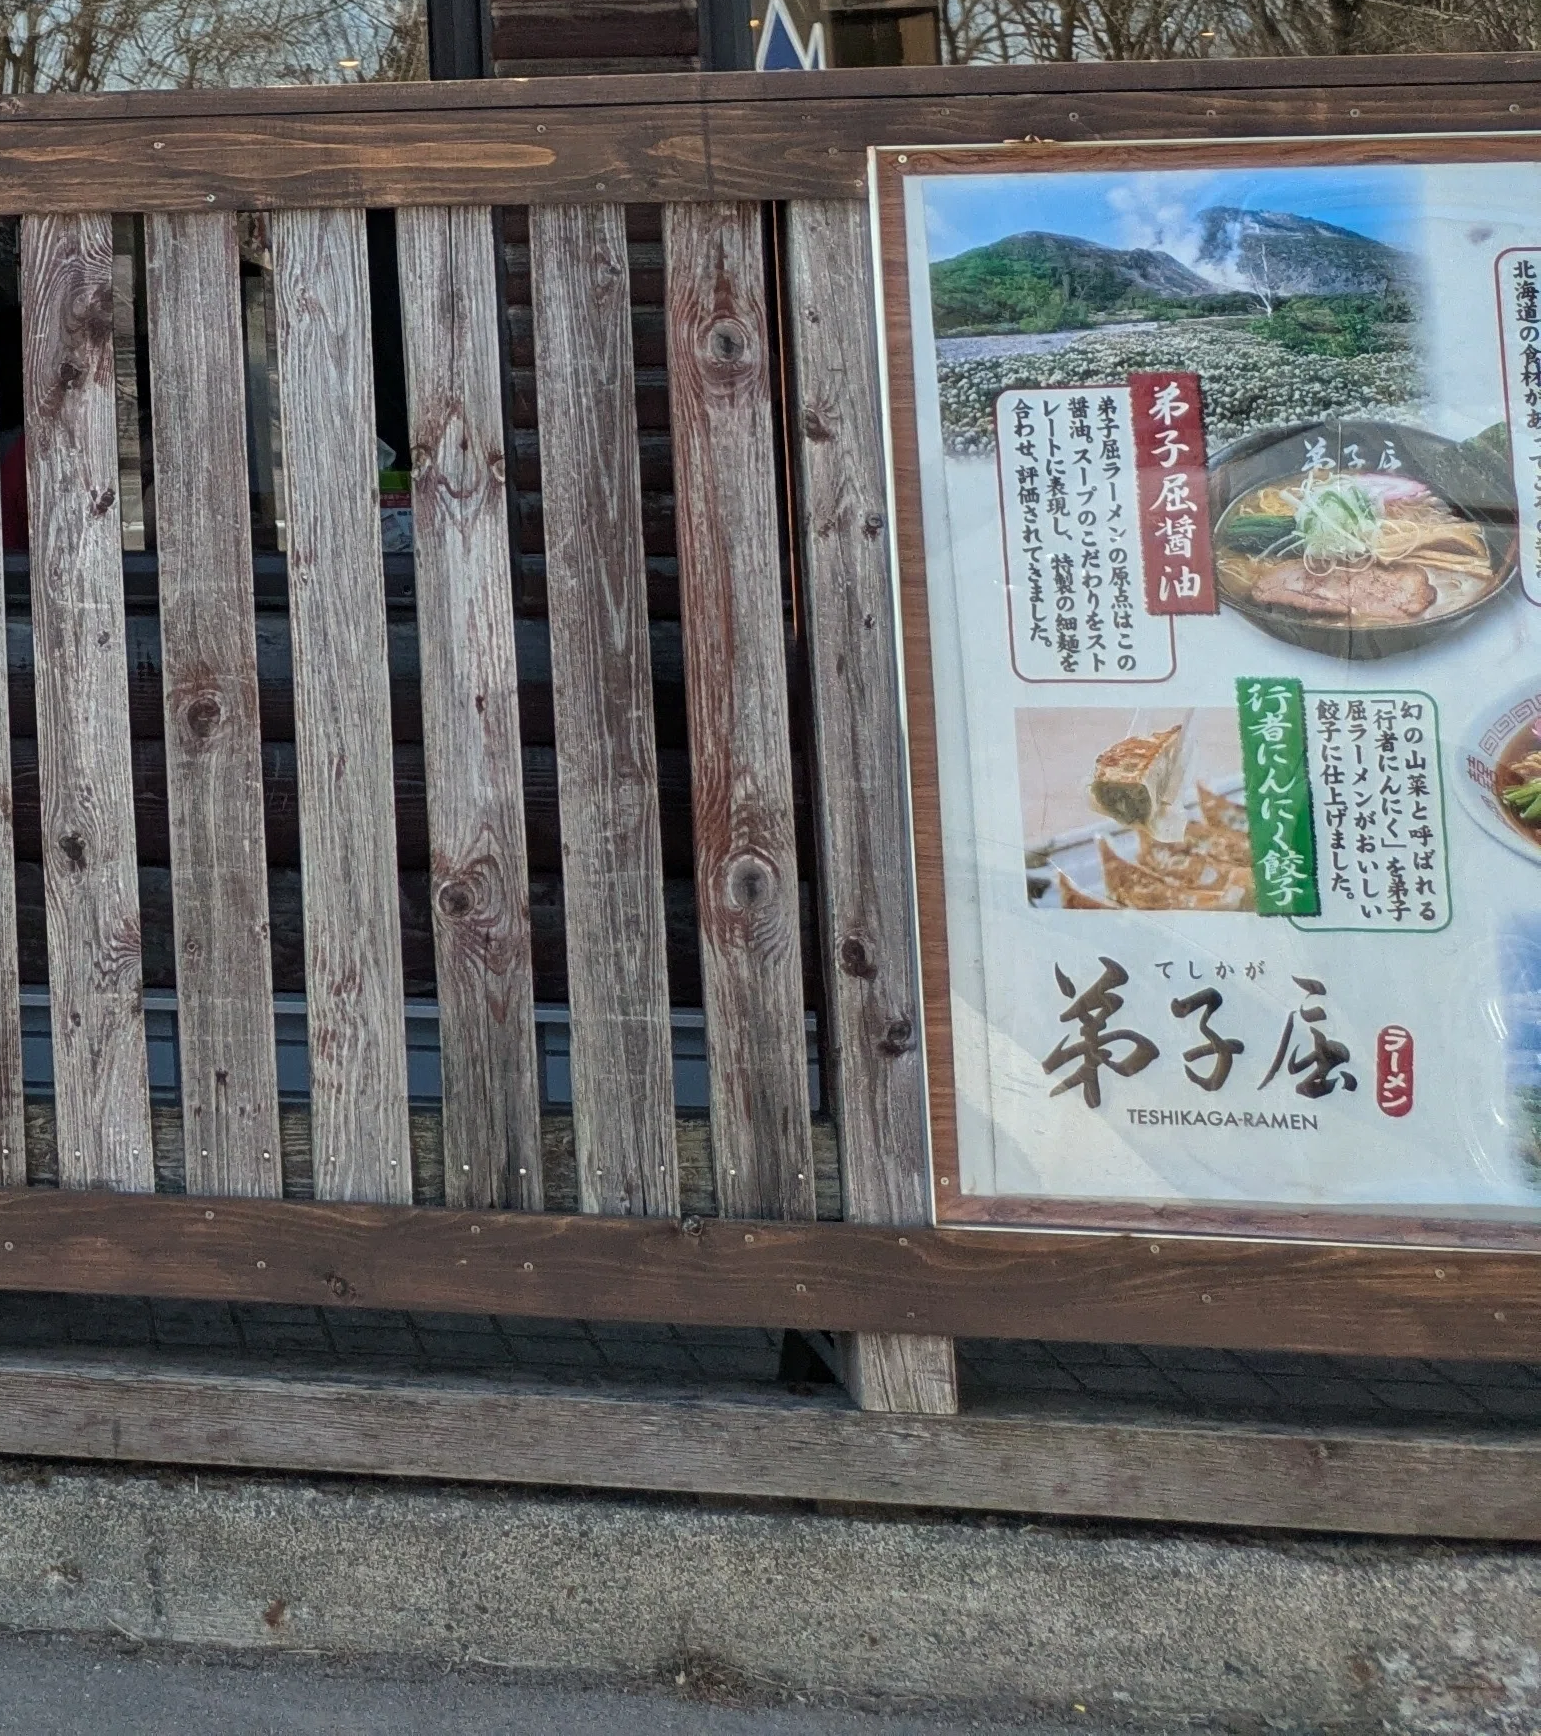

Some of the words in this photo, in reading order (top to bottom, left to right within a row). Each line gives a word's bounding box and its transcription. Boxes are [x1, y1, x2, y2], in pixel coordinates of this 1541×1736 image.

[1011, 398, 1053, 648] 合わせ、評価されてきました。
[1096, 395, 1137, 672] 弟子屈ラーメンの原点はこの
[1244, 683, 1308, 906] 行者にんにく餃子
[1315, 699, 1355, 900] 餃子に仕上げました。
[1345, 700, 1383, 919] 屈ラーメンがおいしい
[1370, 699, 1412, 922] 「行者にんにく」を弟子
[1400, 701, 1437, 921] 幻の山菜と呼ばれる
[1154, 960, 1267, 980] てしかが
[1381, 1028, 1409, 1108] ラーメン
[1127, 1108, 1318, 1131] TESHIKAGA-RAMEN
